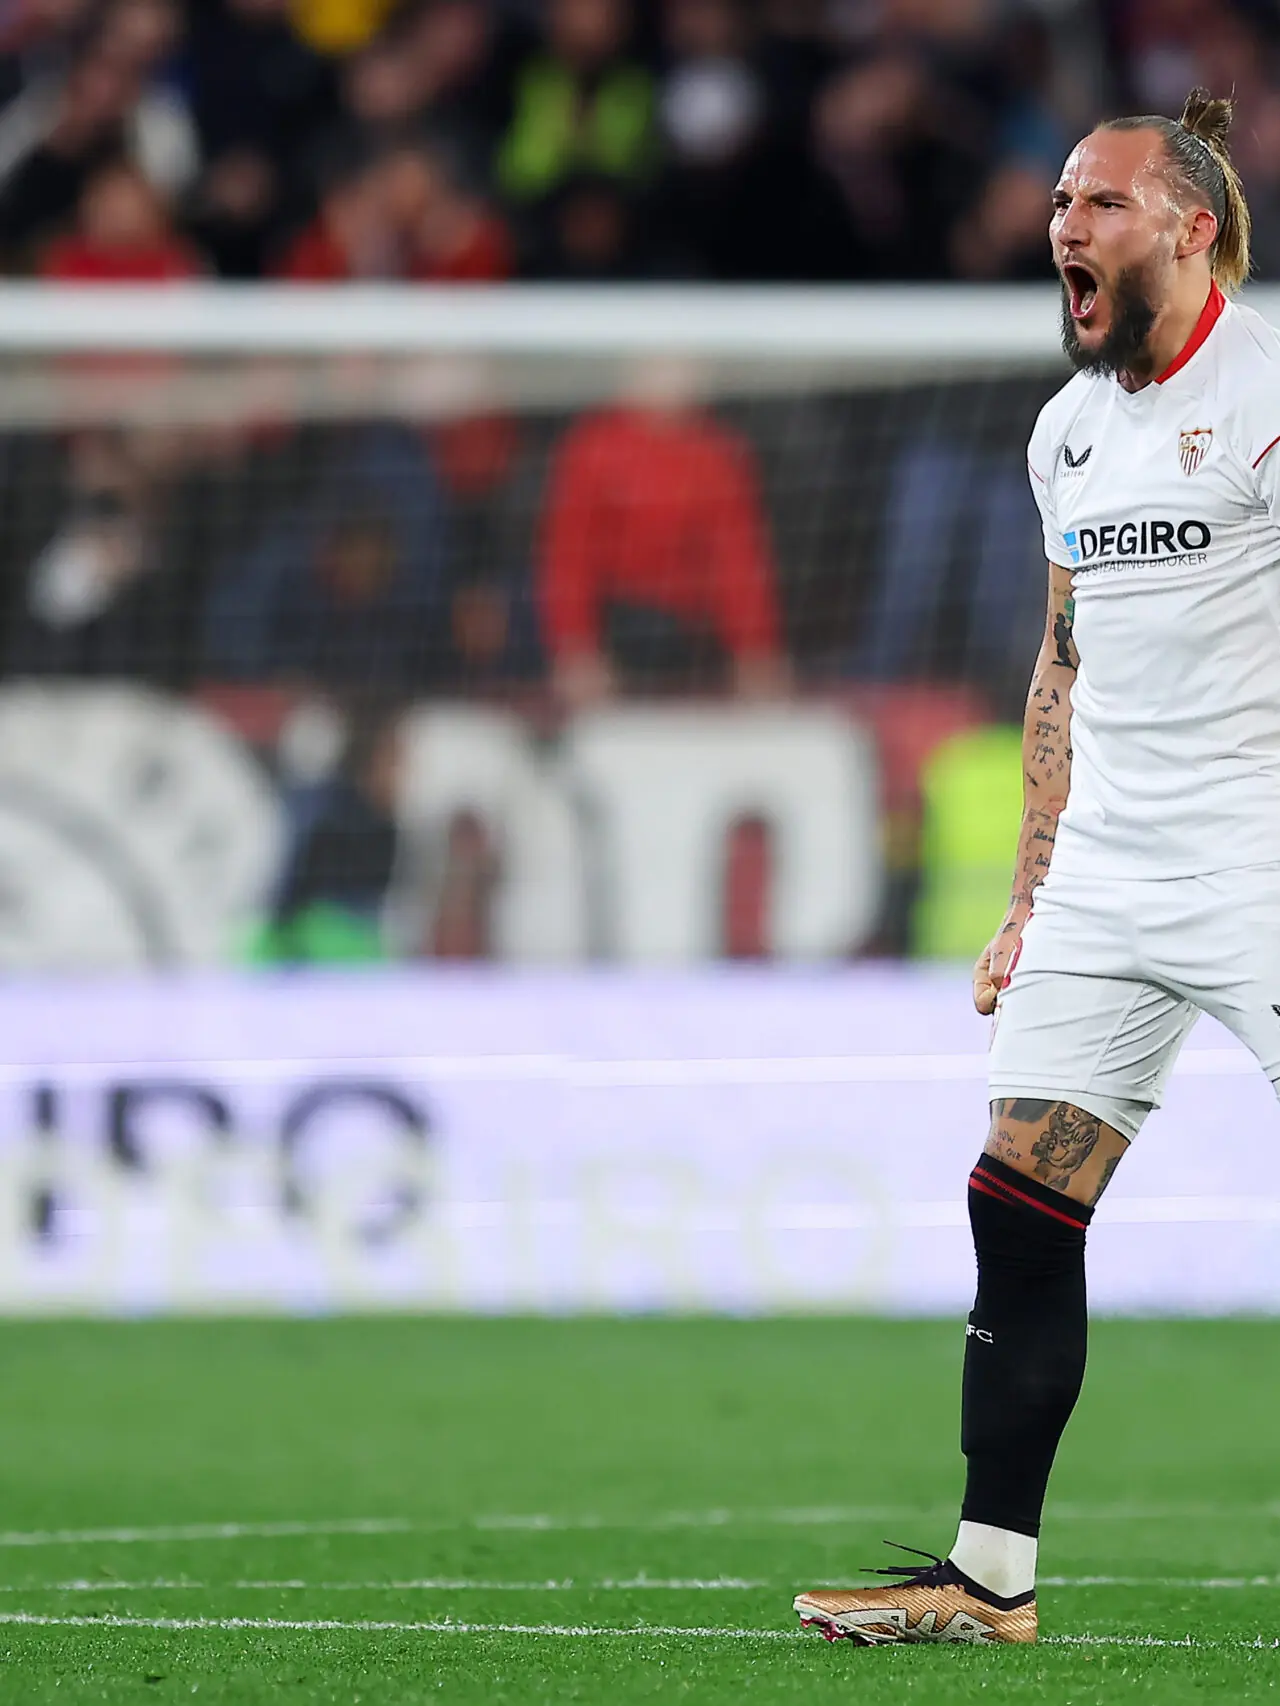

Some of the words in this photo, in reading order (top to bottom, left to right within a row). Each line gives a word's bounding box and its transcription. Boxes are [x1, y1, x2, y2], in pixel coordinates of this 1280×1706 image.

[1079, 519, 1211, 560] DEGIRO
[1149, 552, 1208, 568] BROKER
[965, 1323, 994, 1344] FC
